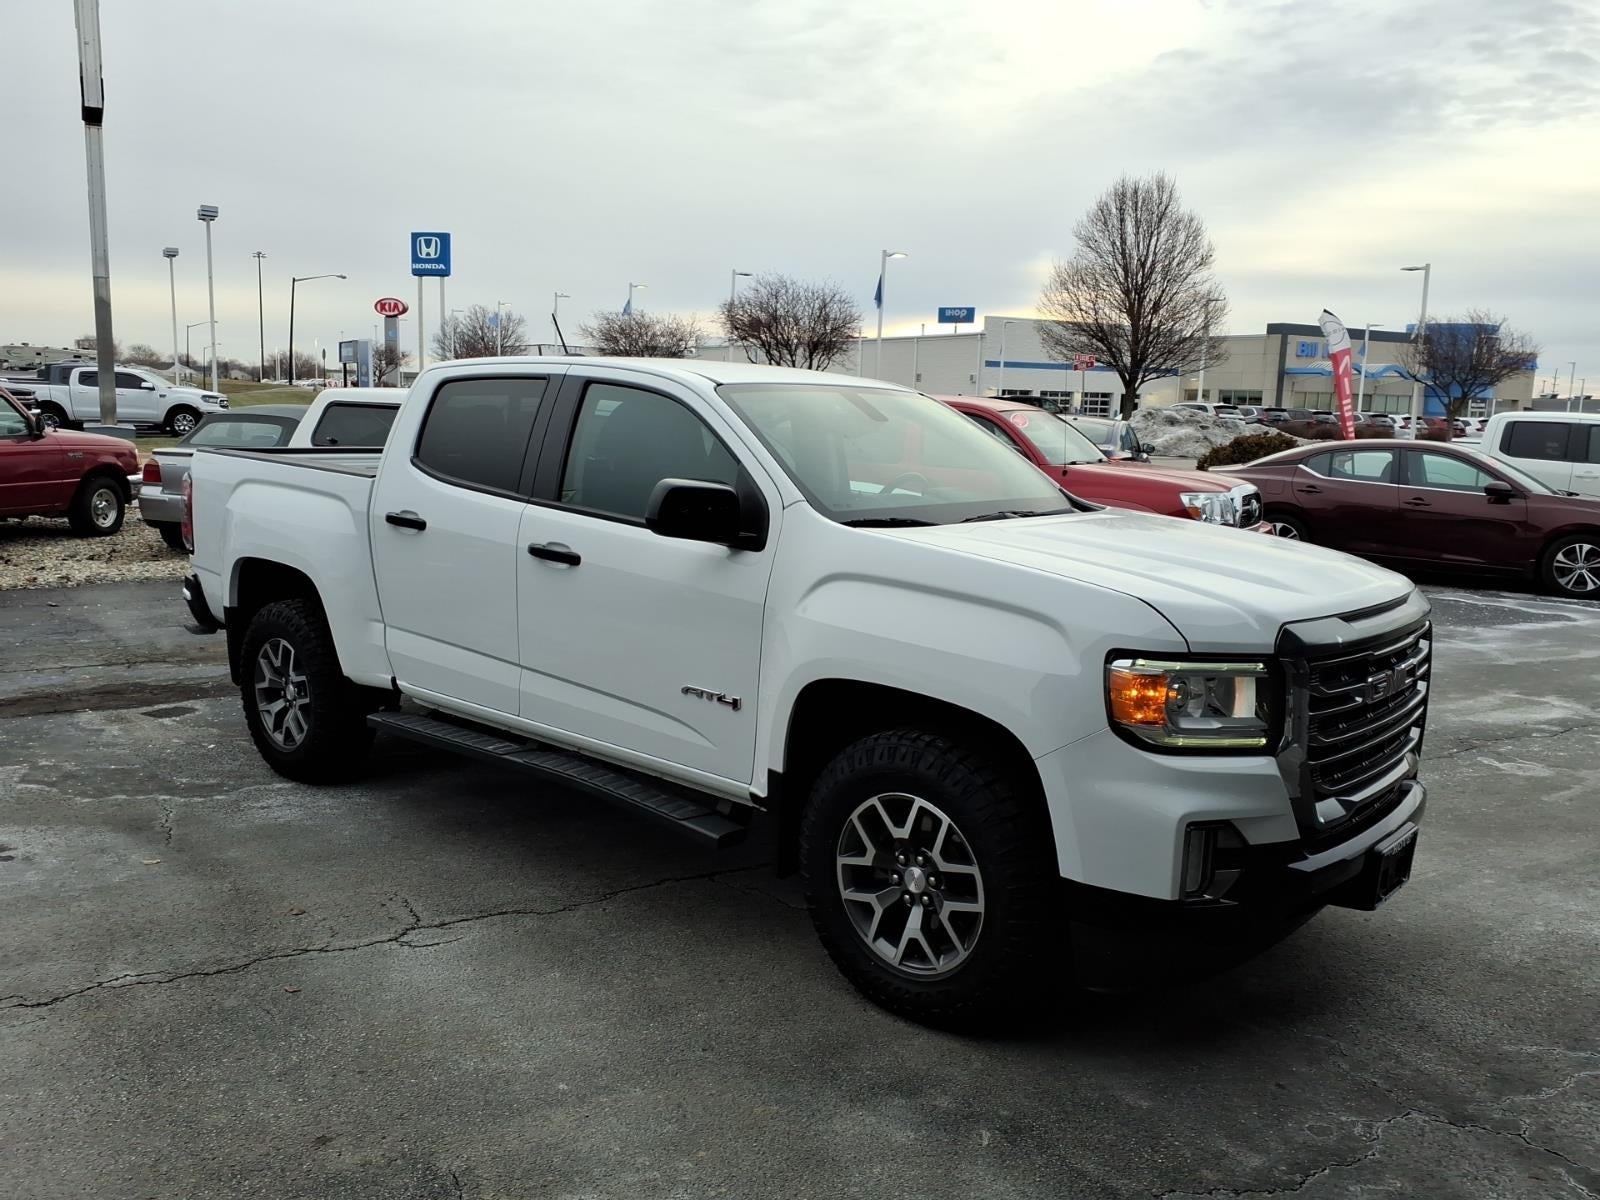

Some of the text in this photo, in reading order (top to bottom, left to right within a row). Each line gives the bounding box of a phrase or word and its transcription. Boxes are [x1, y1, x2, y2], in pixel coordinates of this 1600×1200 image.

[380, 302, 400, 313] KIA
[1296, 341, 1319, 358] Bill
[1367, 658, 1417, 704] GMC
[681, 684, 742, 711] AT4
